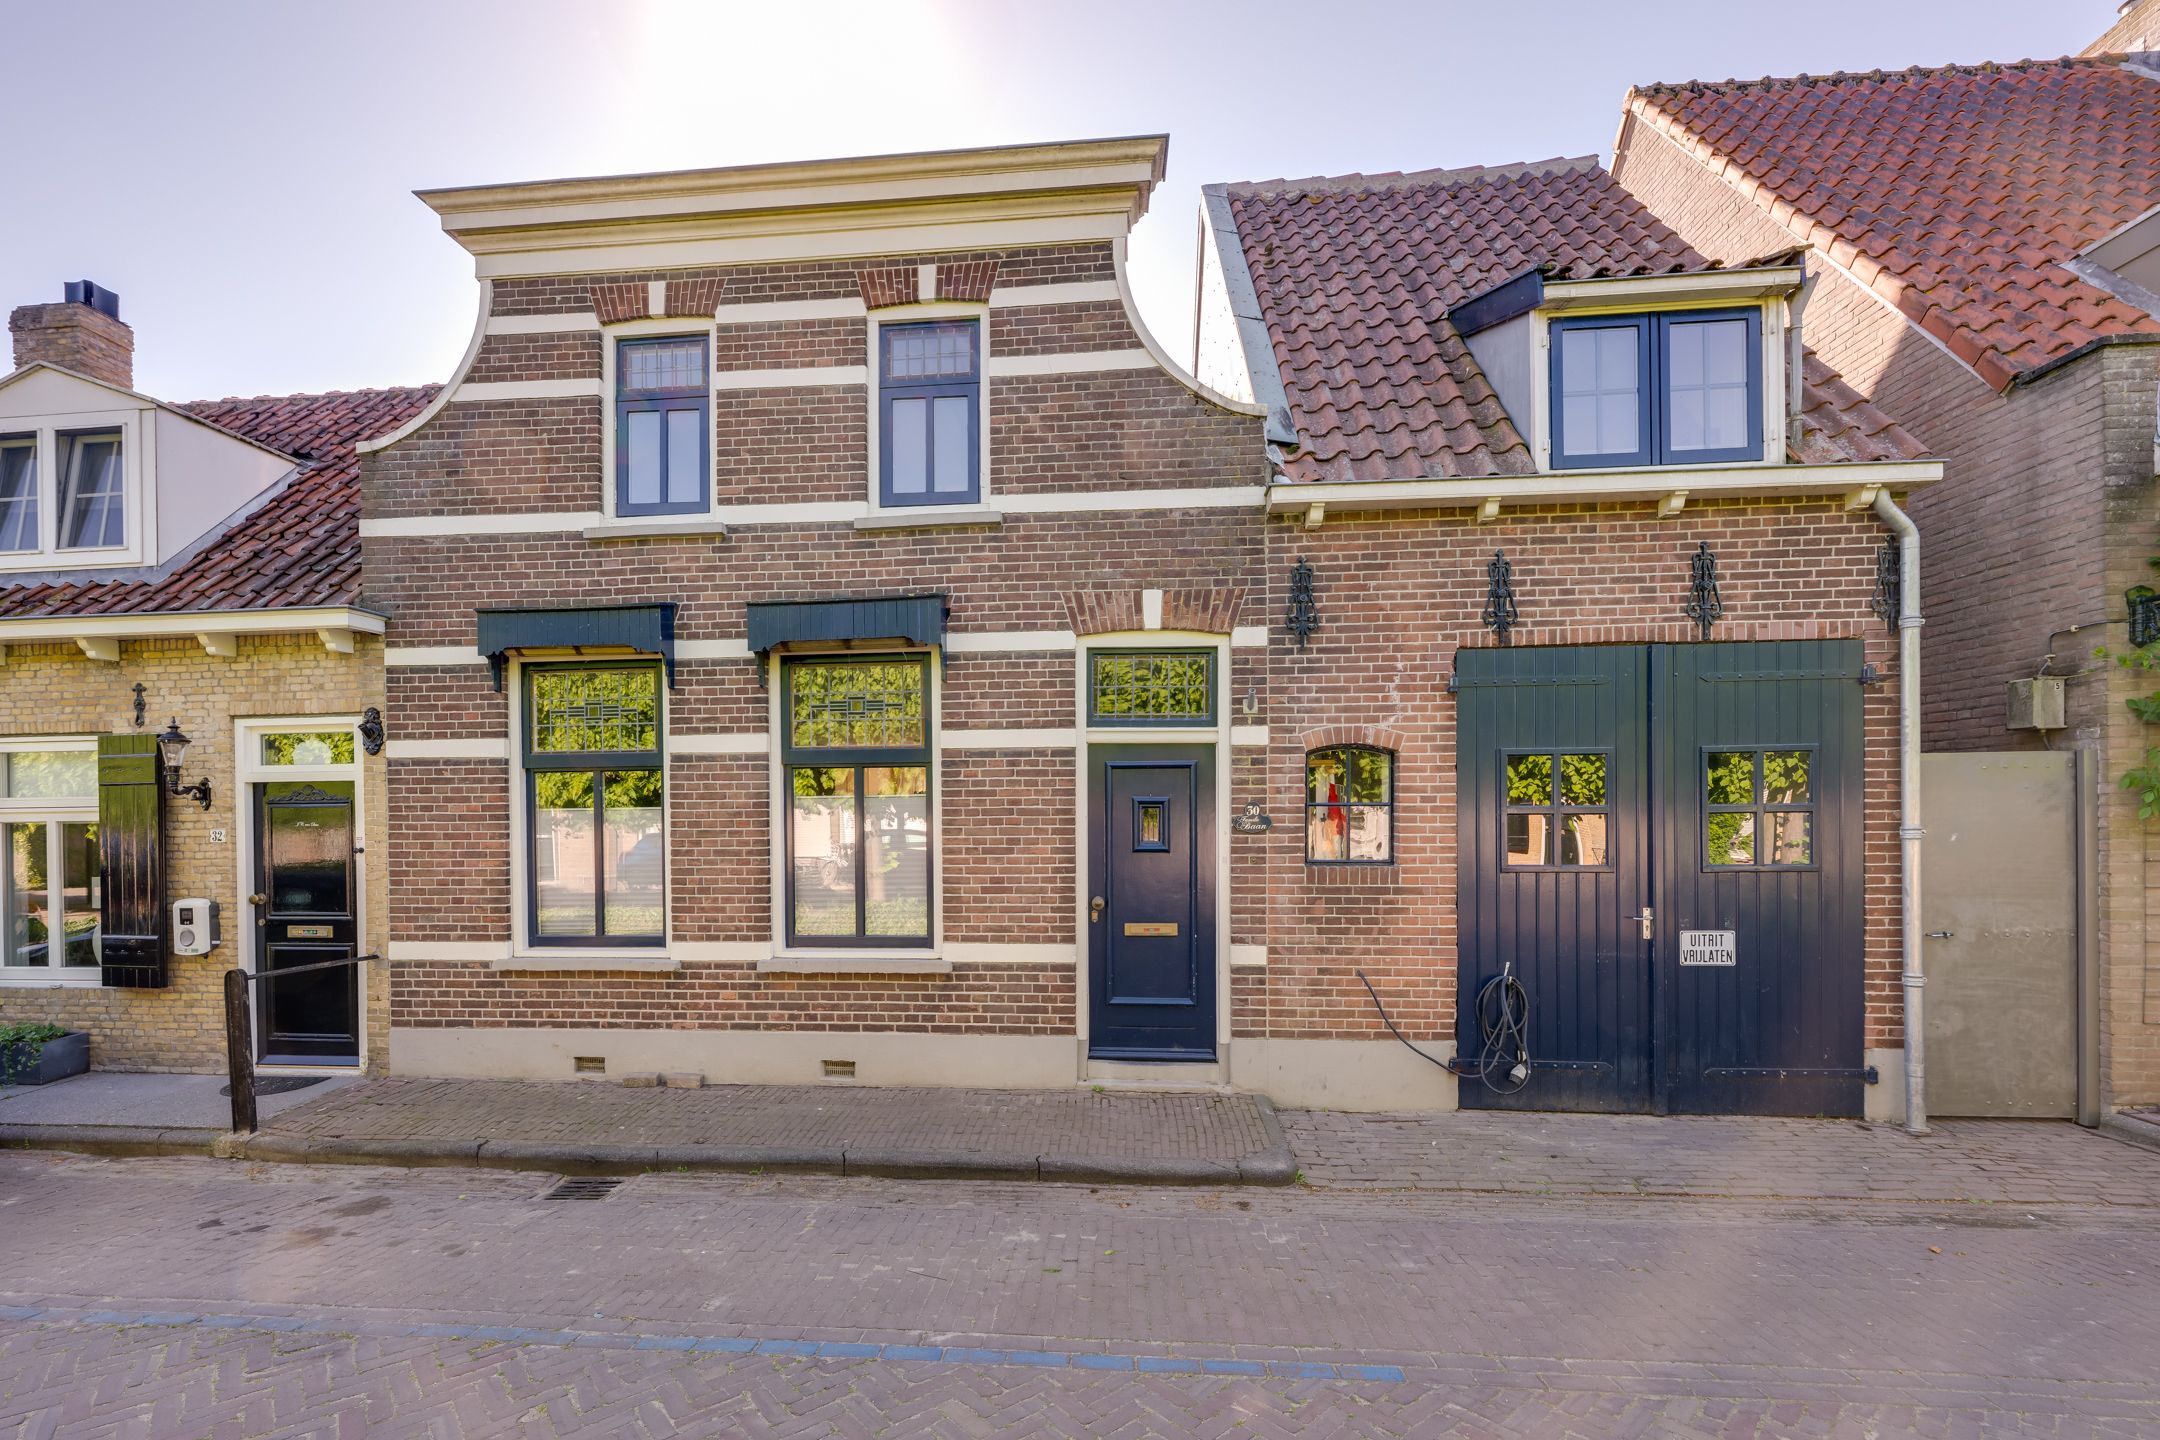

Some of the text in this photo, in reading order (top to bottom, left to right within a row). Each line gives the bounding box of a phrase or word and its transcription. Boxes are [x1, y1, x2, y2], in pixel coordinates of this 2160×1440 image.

[1246, 805, 1260, 816] 30
[212, 830, 223, 842] 32
[1690, 934, 1724, 947] UITRIT
[1682, 949, 1733, 963] VRIJLATEN
